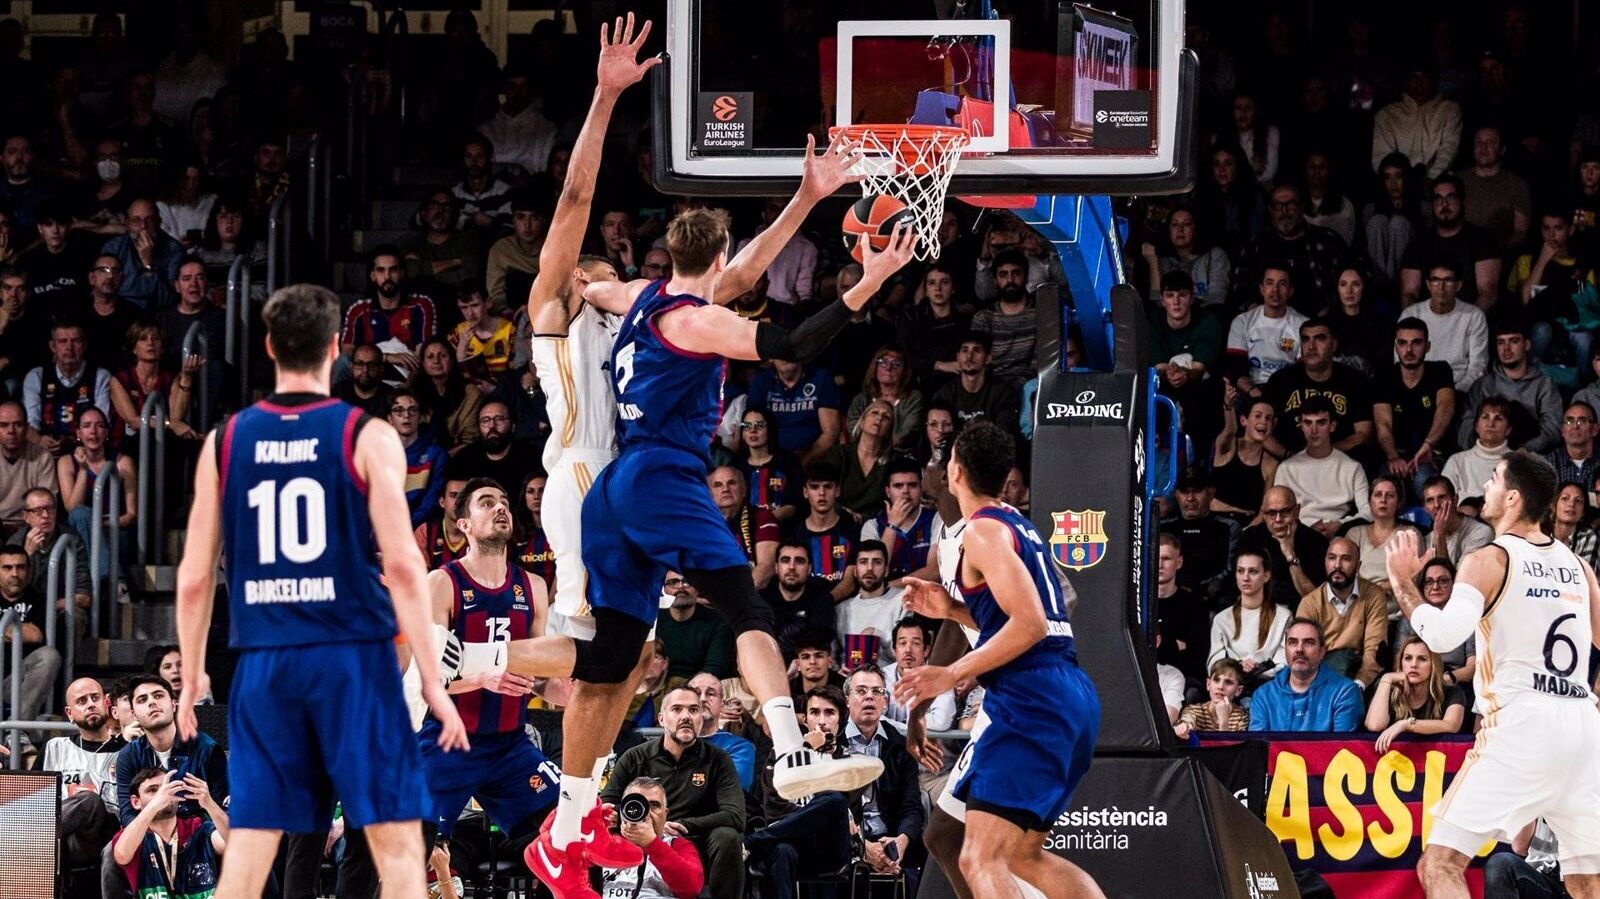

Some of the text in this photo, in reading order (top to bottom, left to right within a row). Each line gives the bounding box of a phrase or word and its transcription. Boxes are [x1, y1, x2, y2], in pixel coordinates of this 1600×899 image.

[705, 122, 745, 131] TURKISH
[1109, 114, 1148, 123] oneteam
[703, 139, 745, 148] EuroLeague
[704, 131, 745, 139] AIRLINES
[247, 477, 327, 565] 10
[245, 576, 336, 605] BARCELONA
[485, 617, 511, 643] 13
[1542, 613, 1578, 678] 6
[64, 773, 80, 785] 24
[1265, 748, 1498, 861] ASSI
[1054, 806, 1168, 827] ssistència
[1041, 829, 1129, 850] Sanitària
